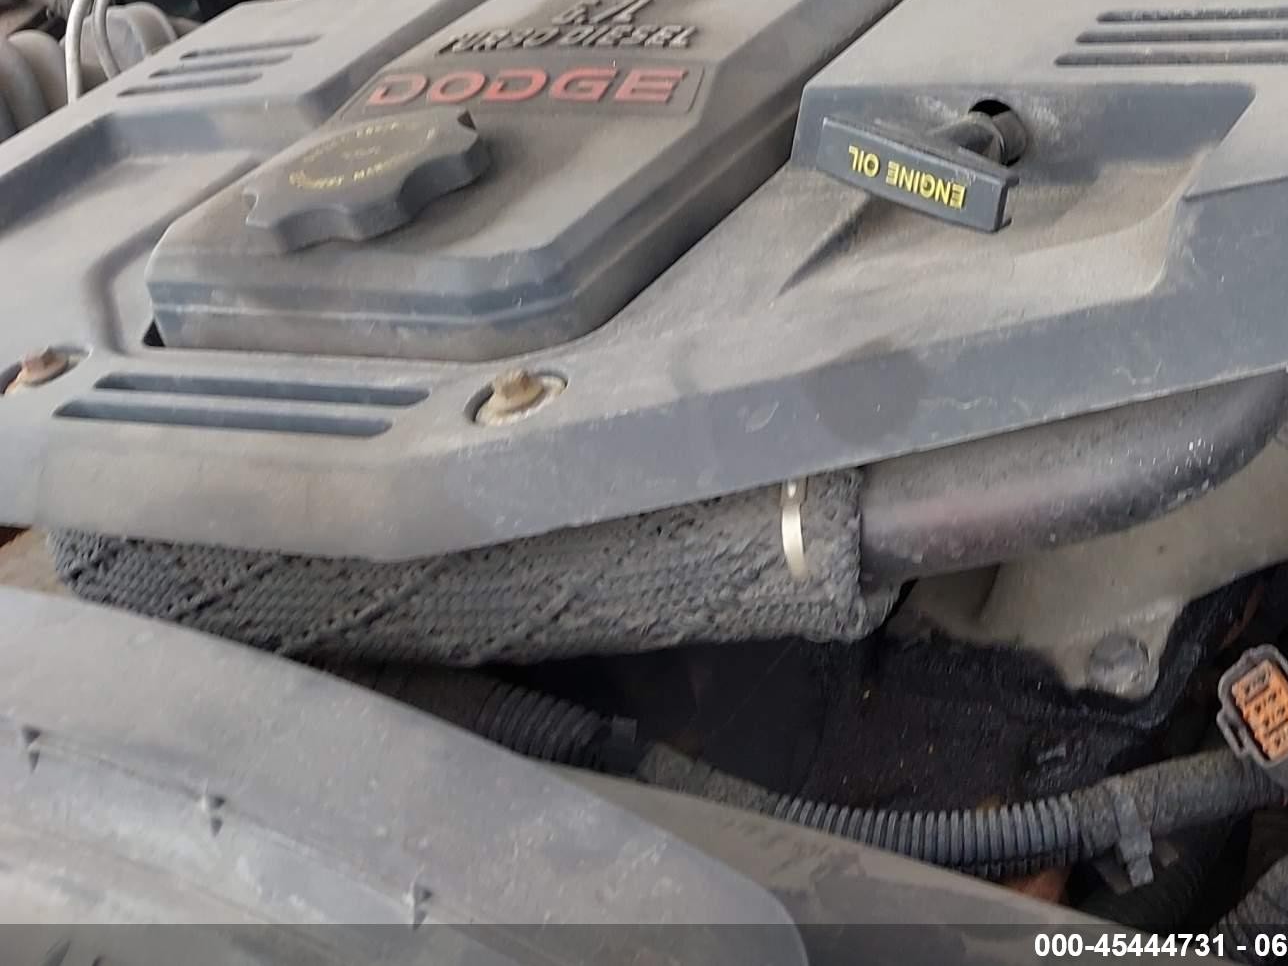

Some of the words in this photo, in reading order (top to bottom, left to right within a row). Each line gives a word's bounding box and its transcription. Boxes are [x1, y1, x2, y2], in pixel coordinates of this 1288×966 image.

[434, 26, 562, 56] TURBO
[555, 24, 699, 51] DIESEL
[365, 68, 690, 107] DODGE
[848, 145, 881, 178] OIL
[884, 160, 967, 210] ENGINE
